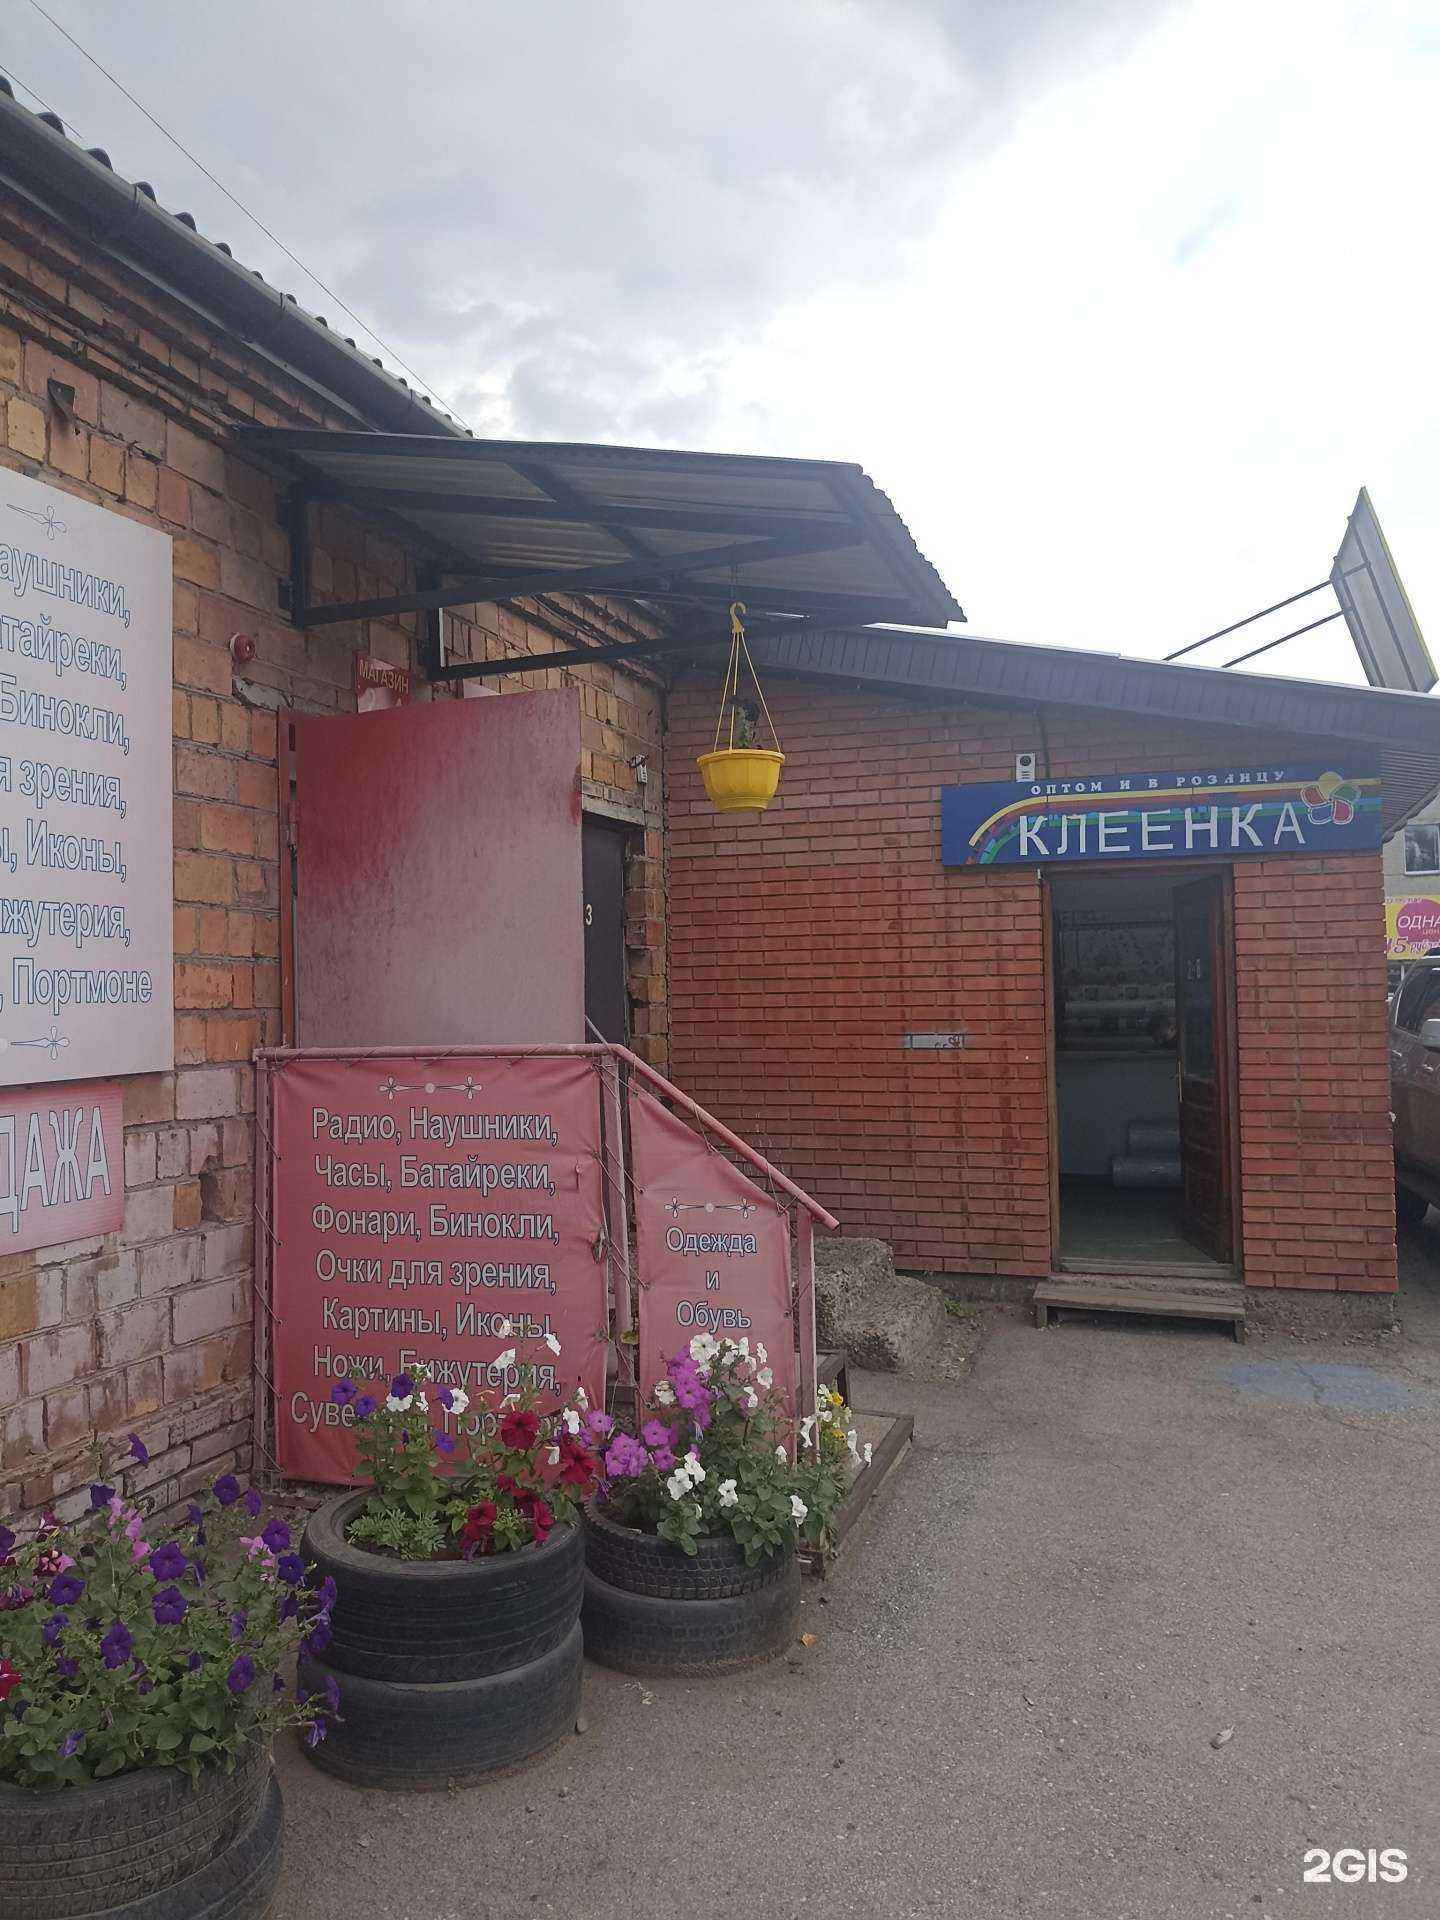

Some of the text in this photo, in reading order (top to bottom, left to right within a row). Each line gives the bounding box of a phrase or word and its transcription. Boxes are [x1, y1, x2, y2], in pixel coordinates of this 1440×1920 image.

[0, 613, 127, 691] тайреки,
[359, 659, 409, 695] МАГАЗИН
[0, 672, 129, 755] Бинокли,
[20, 760, 127, 818] зрения,
[1030, 781, 1102, 796] ОПТОМ
[1148, 777, 1158, 789] В
[26, 818, 127, 883] Иконы,
[1019, 801, 1307, 857] КЛЕЕНКА
[0, 898, 131, 947] жутерия,
[13, 957, 152, 1015] Портмоне
[312, 1106, 559, 1148] Радио, Наушники,
[314, 1154, 556, 1197] Часы, Батайреки,
[312, 1202, 560, 1245] Фонари, Бинокли,
[666, 1226, 757, 1257] Одежда
[315, 1249, 557, 1295] Очки для зрения,
[705, 1270, 720, 1290] и
[322, 1296, 448, 1340] Картины,
[676, 1300, 752, 1334] Обувь
